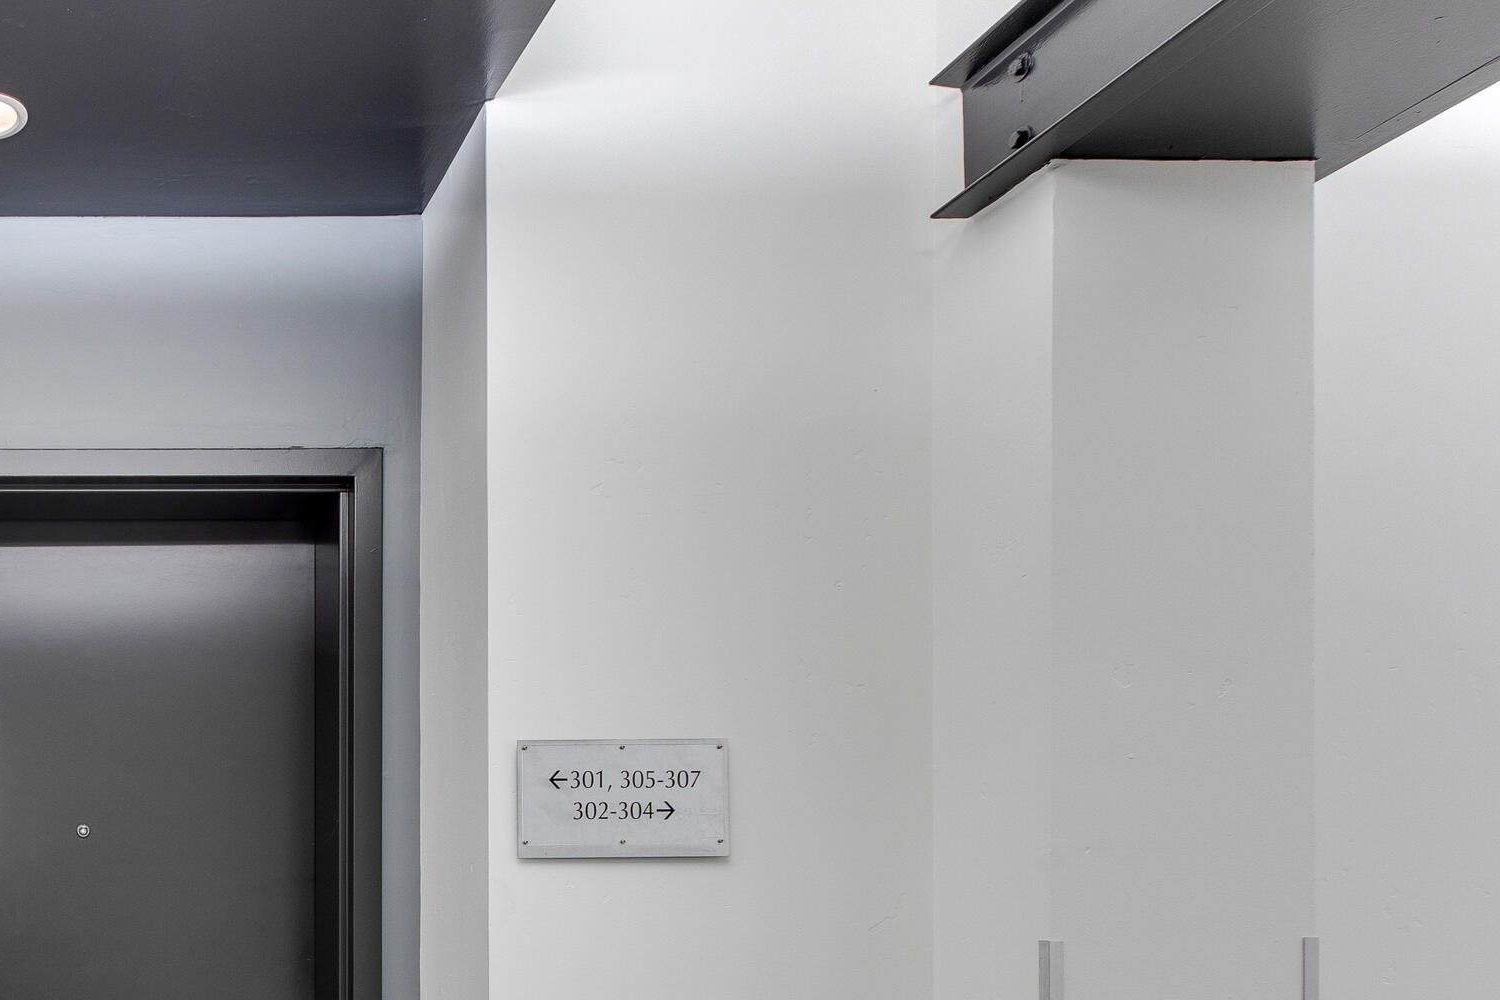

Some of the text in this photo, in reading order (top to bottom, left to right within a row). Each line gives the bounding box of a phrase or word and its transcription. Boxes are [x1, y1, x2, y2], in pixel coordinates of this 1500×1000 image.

[570, 769, 702, 793] 301, 305-307
[572, 801, 655, 820] 302-304
